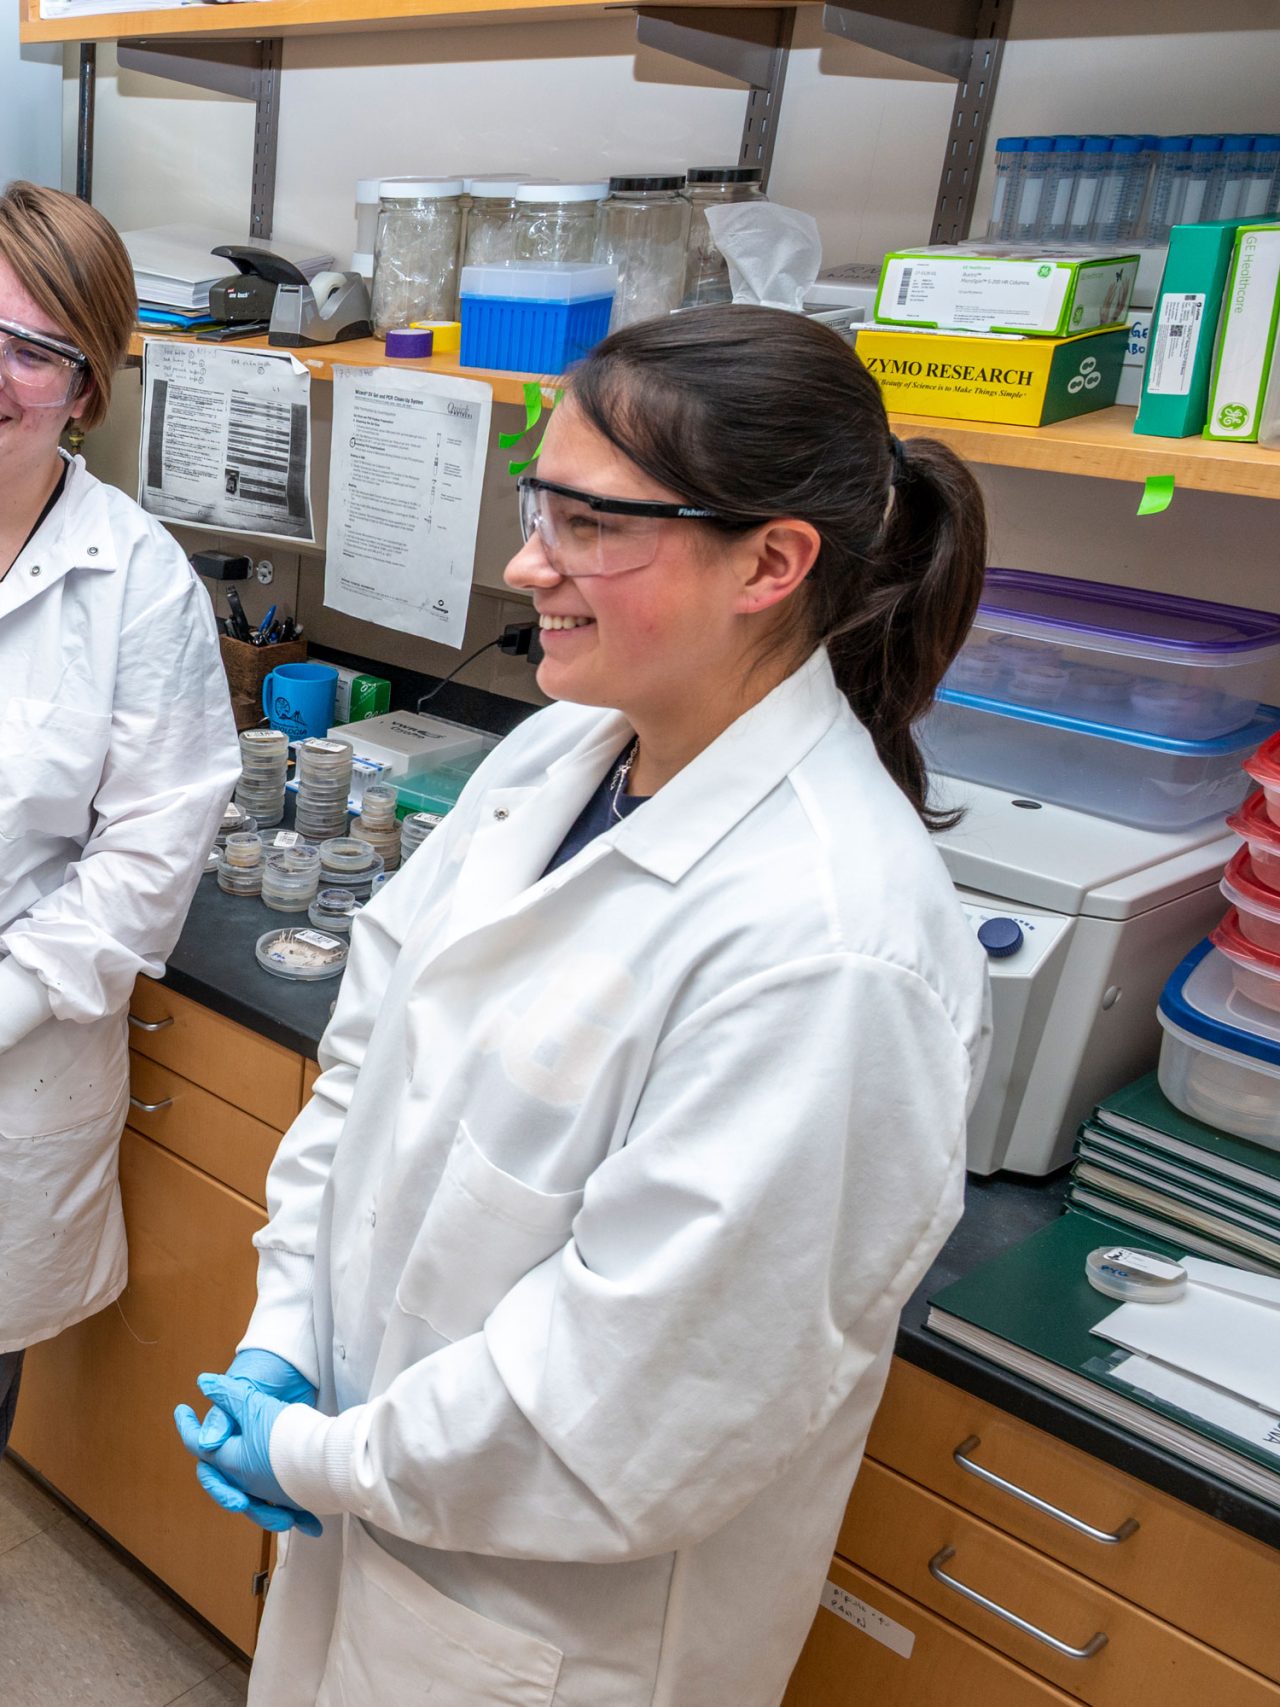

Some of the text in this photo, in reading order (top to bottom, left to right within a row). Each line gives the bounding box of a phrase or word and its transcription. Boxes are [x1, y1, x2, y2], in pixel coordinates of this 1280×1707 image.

[867, 357, 1034, 387] ZYMO RESEARCH
[880, 379, 903, 389] Beauty
[911, 382, 937, 391] Science
[952, 386, 973, 394] Make
[974, 387, 998, 397] Things
